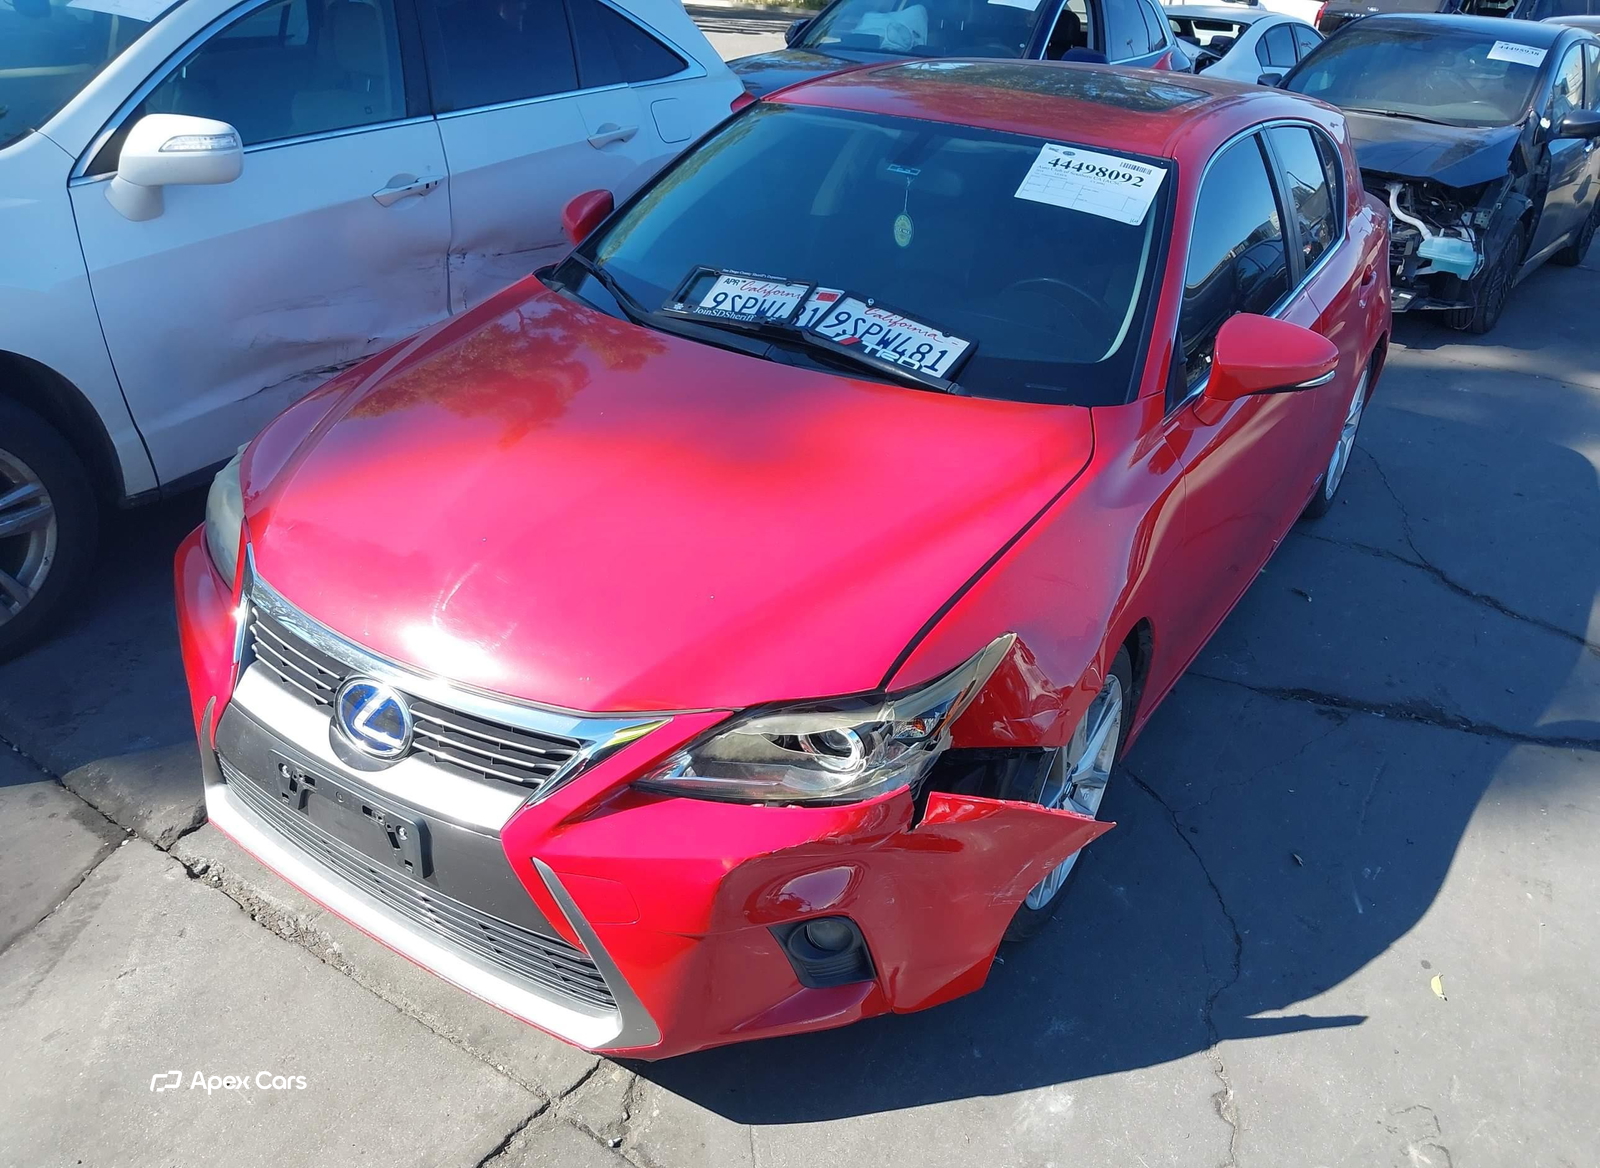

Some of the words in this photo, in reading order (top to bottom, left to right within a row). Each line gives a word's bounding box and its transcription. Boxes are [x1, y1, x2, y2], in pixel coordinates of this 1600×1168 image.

[1048, 157, 1145, 188] 44498092
[723, 277, 741, 287] APR
[740, 281, 804, 300] Californi
[864, 307, 944, 343] California
[823, 311, 949, 373] 9SPW481
